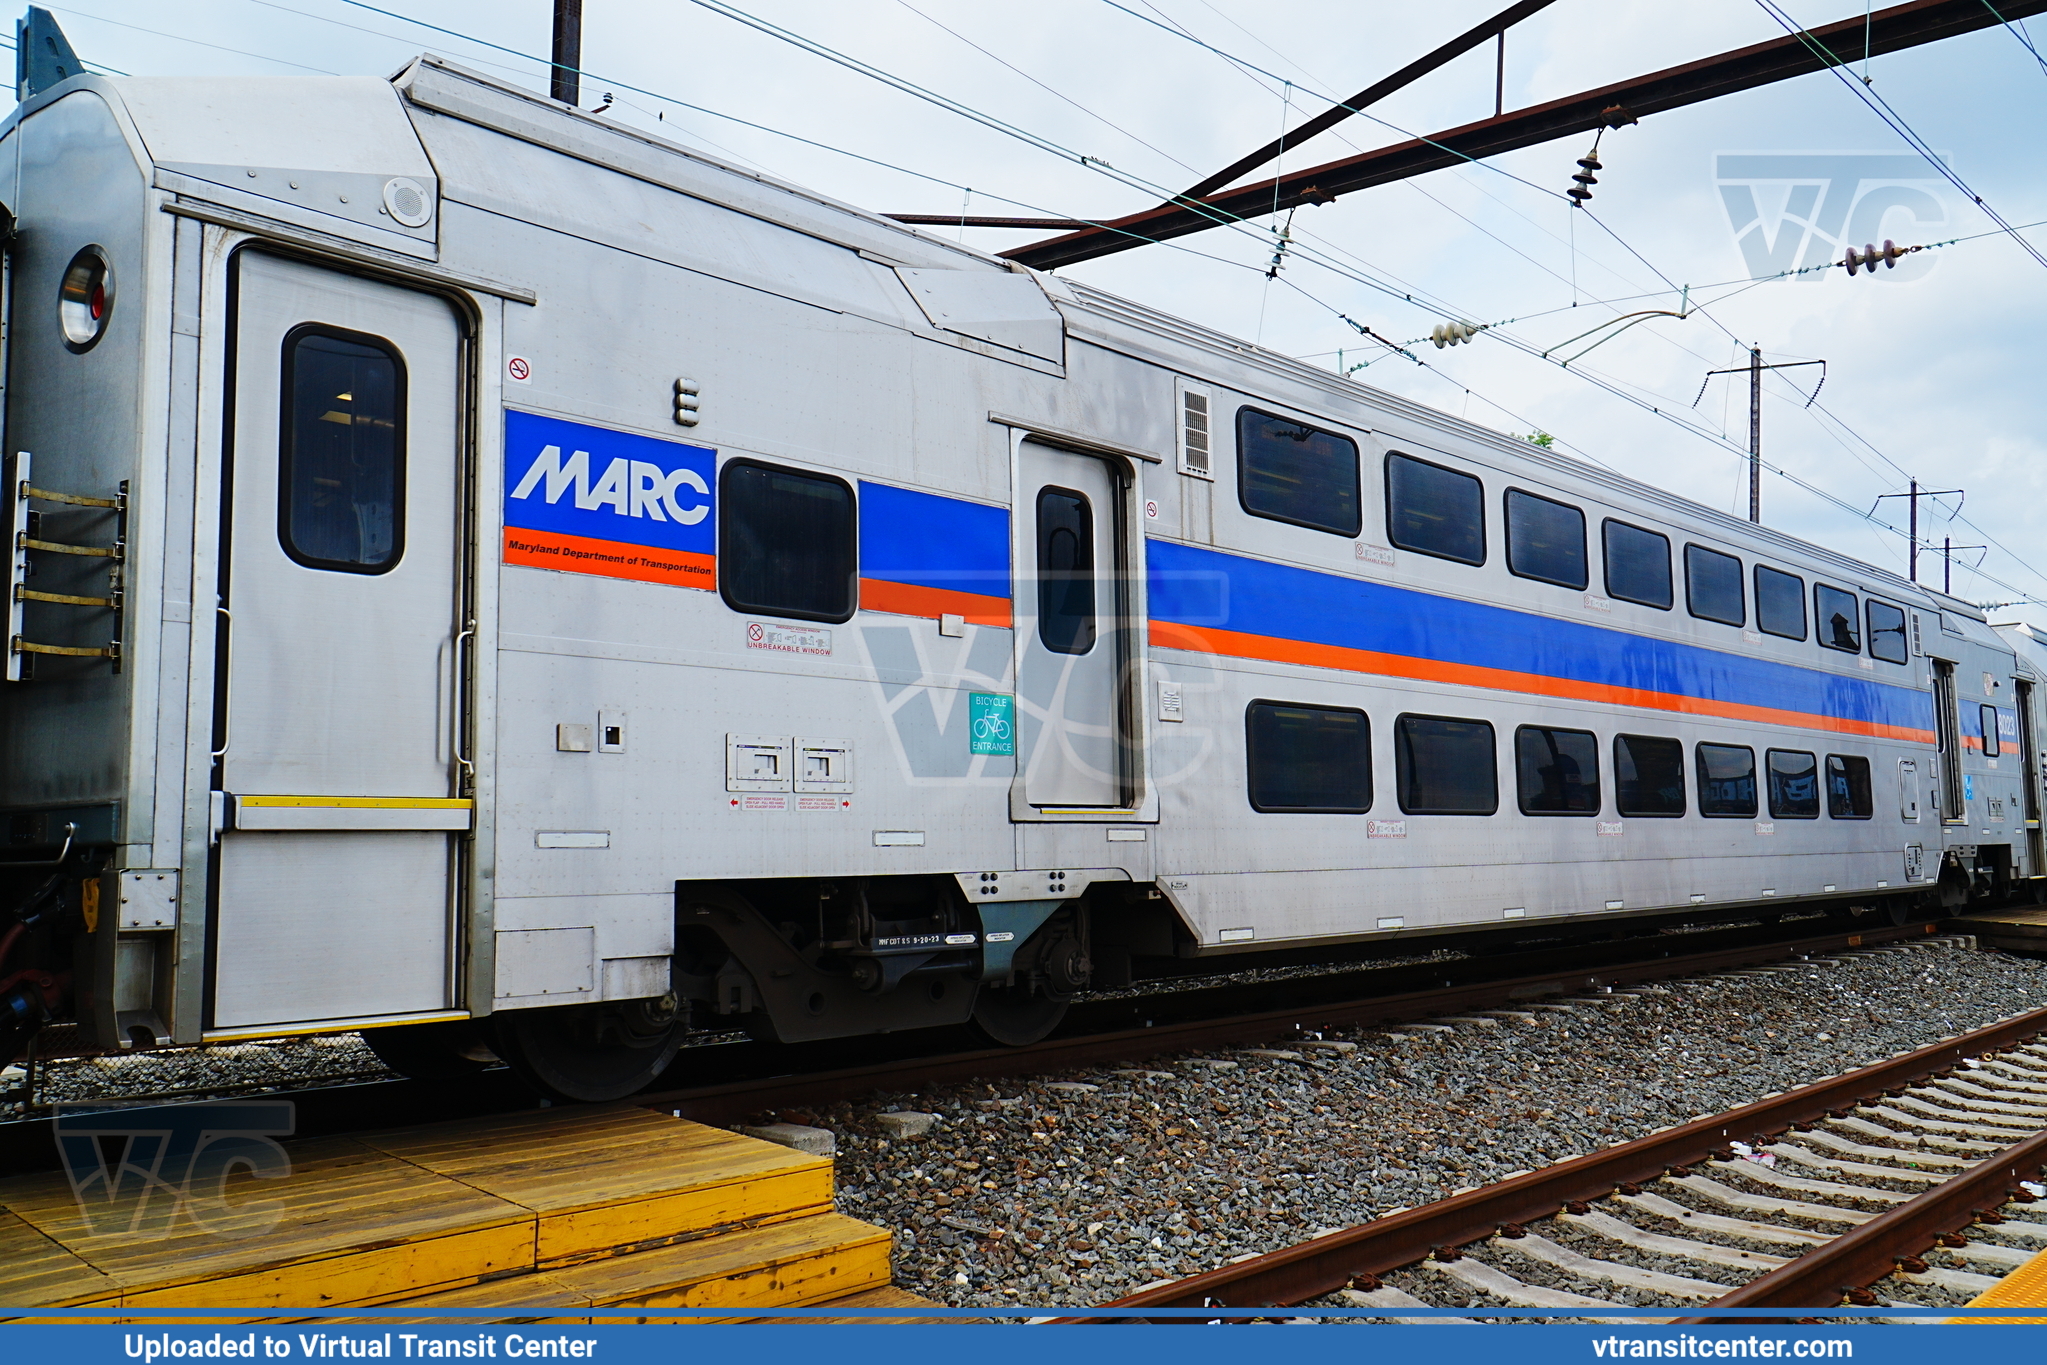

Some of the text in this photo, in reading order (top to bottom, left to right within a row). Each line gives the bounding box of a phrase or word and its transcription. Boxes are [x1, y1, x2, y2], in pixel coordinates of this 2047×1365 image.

[510, 444, 710, 526] MARC
[508, 540, 712, 576] Maryland Department of Transportation
[748, 641, 831, 655] UNBREAKABLE WINDOW
[975, 696, 1007, 707] BICYCLE
[1998, 713, 2015, 736] 8023
[972, 741, 1012, 752] ENTRANCE
